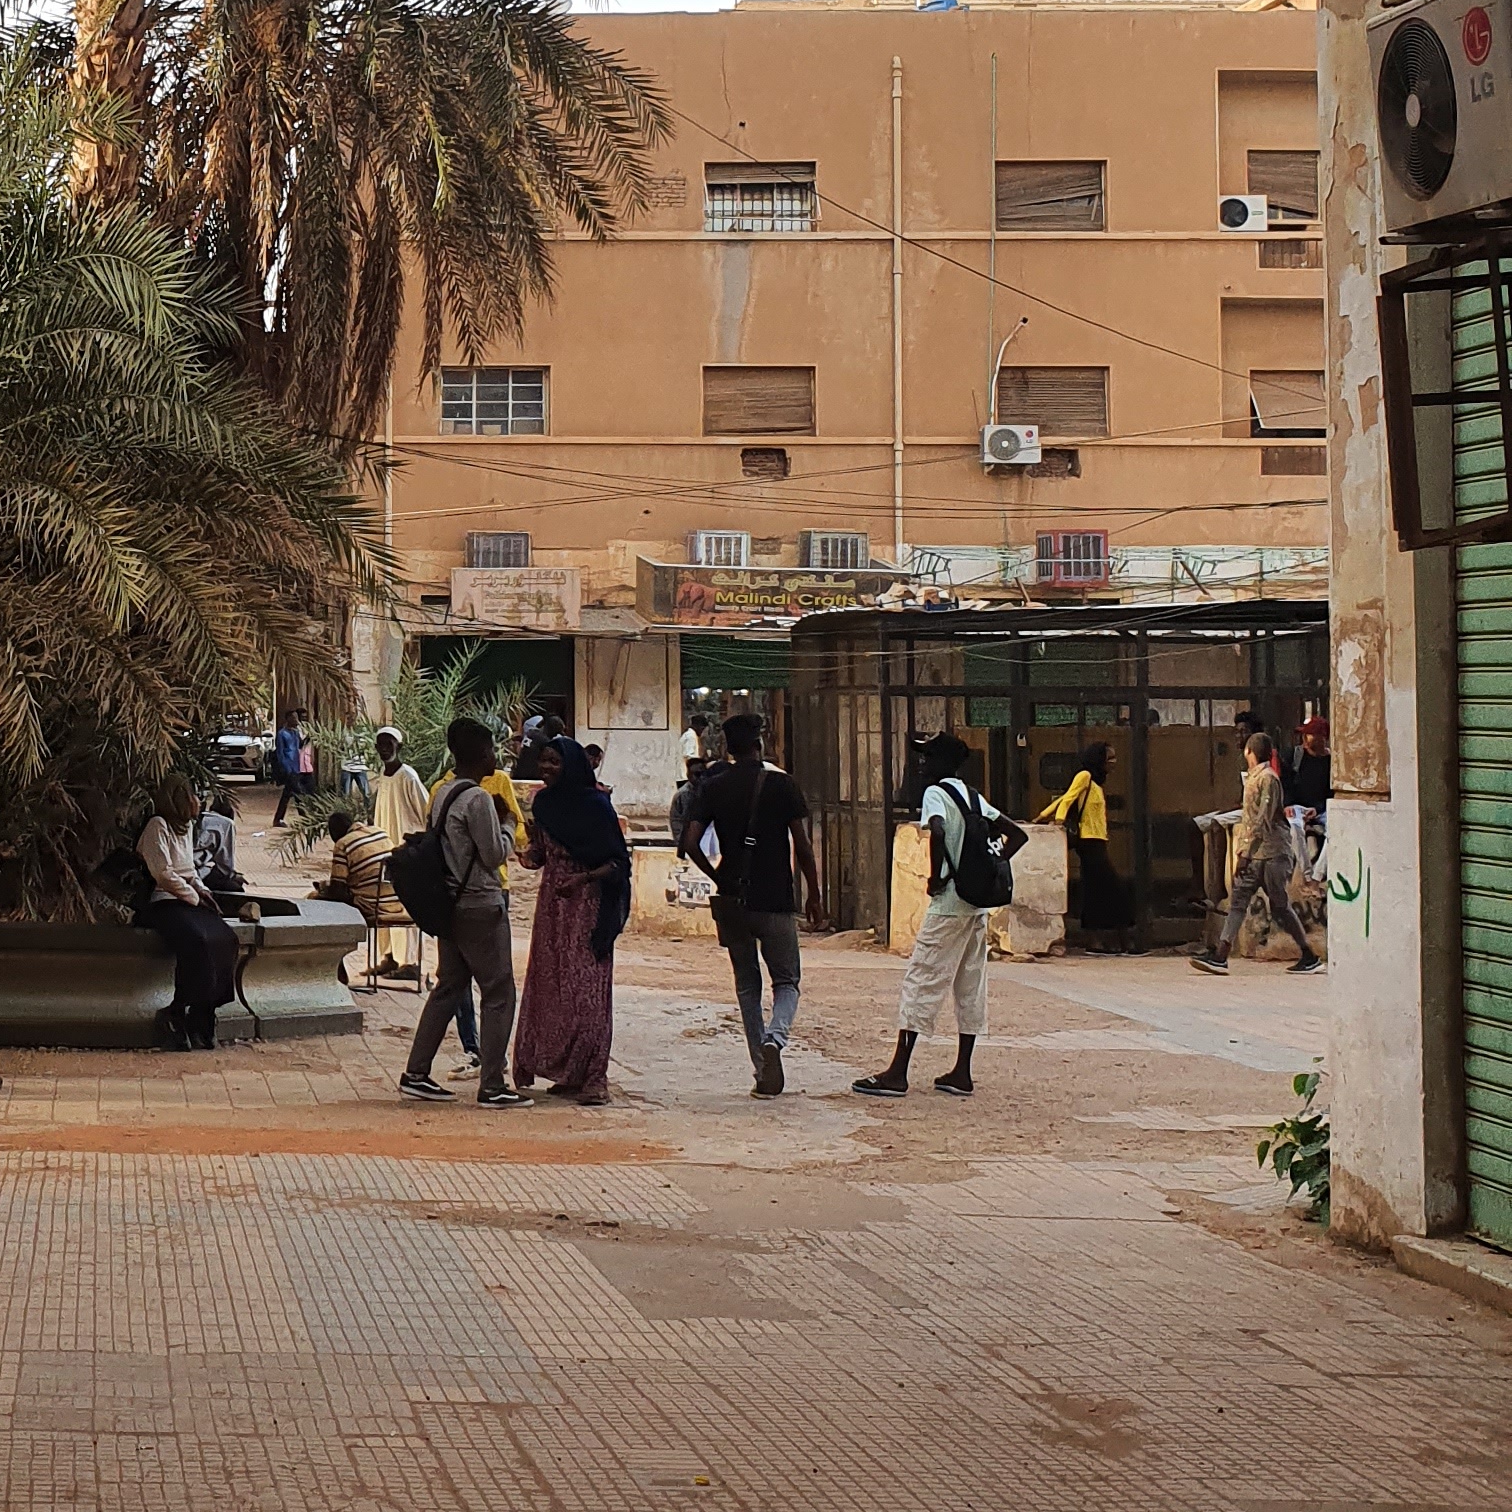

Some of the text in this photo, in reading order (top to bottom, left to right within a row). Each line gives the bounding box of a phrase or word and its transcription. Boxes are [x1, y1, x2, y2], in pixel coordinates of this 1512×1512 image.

[1470, 71, 1495, 103] LG
[715, 591, 857, 607] Malindi Crafts
